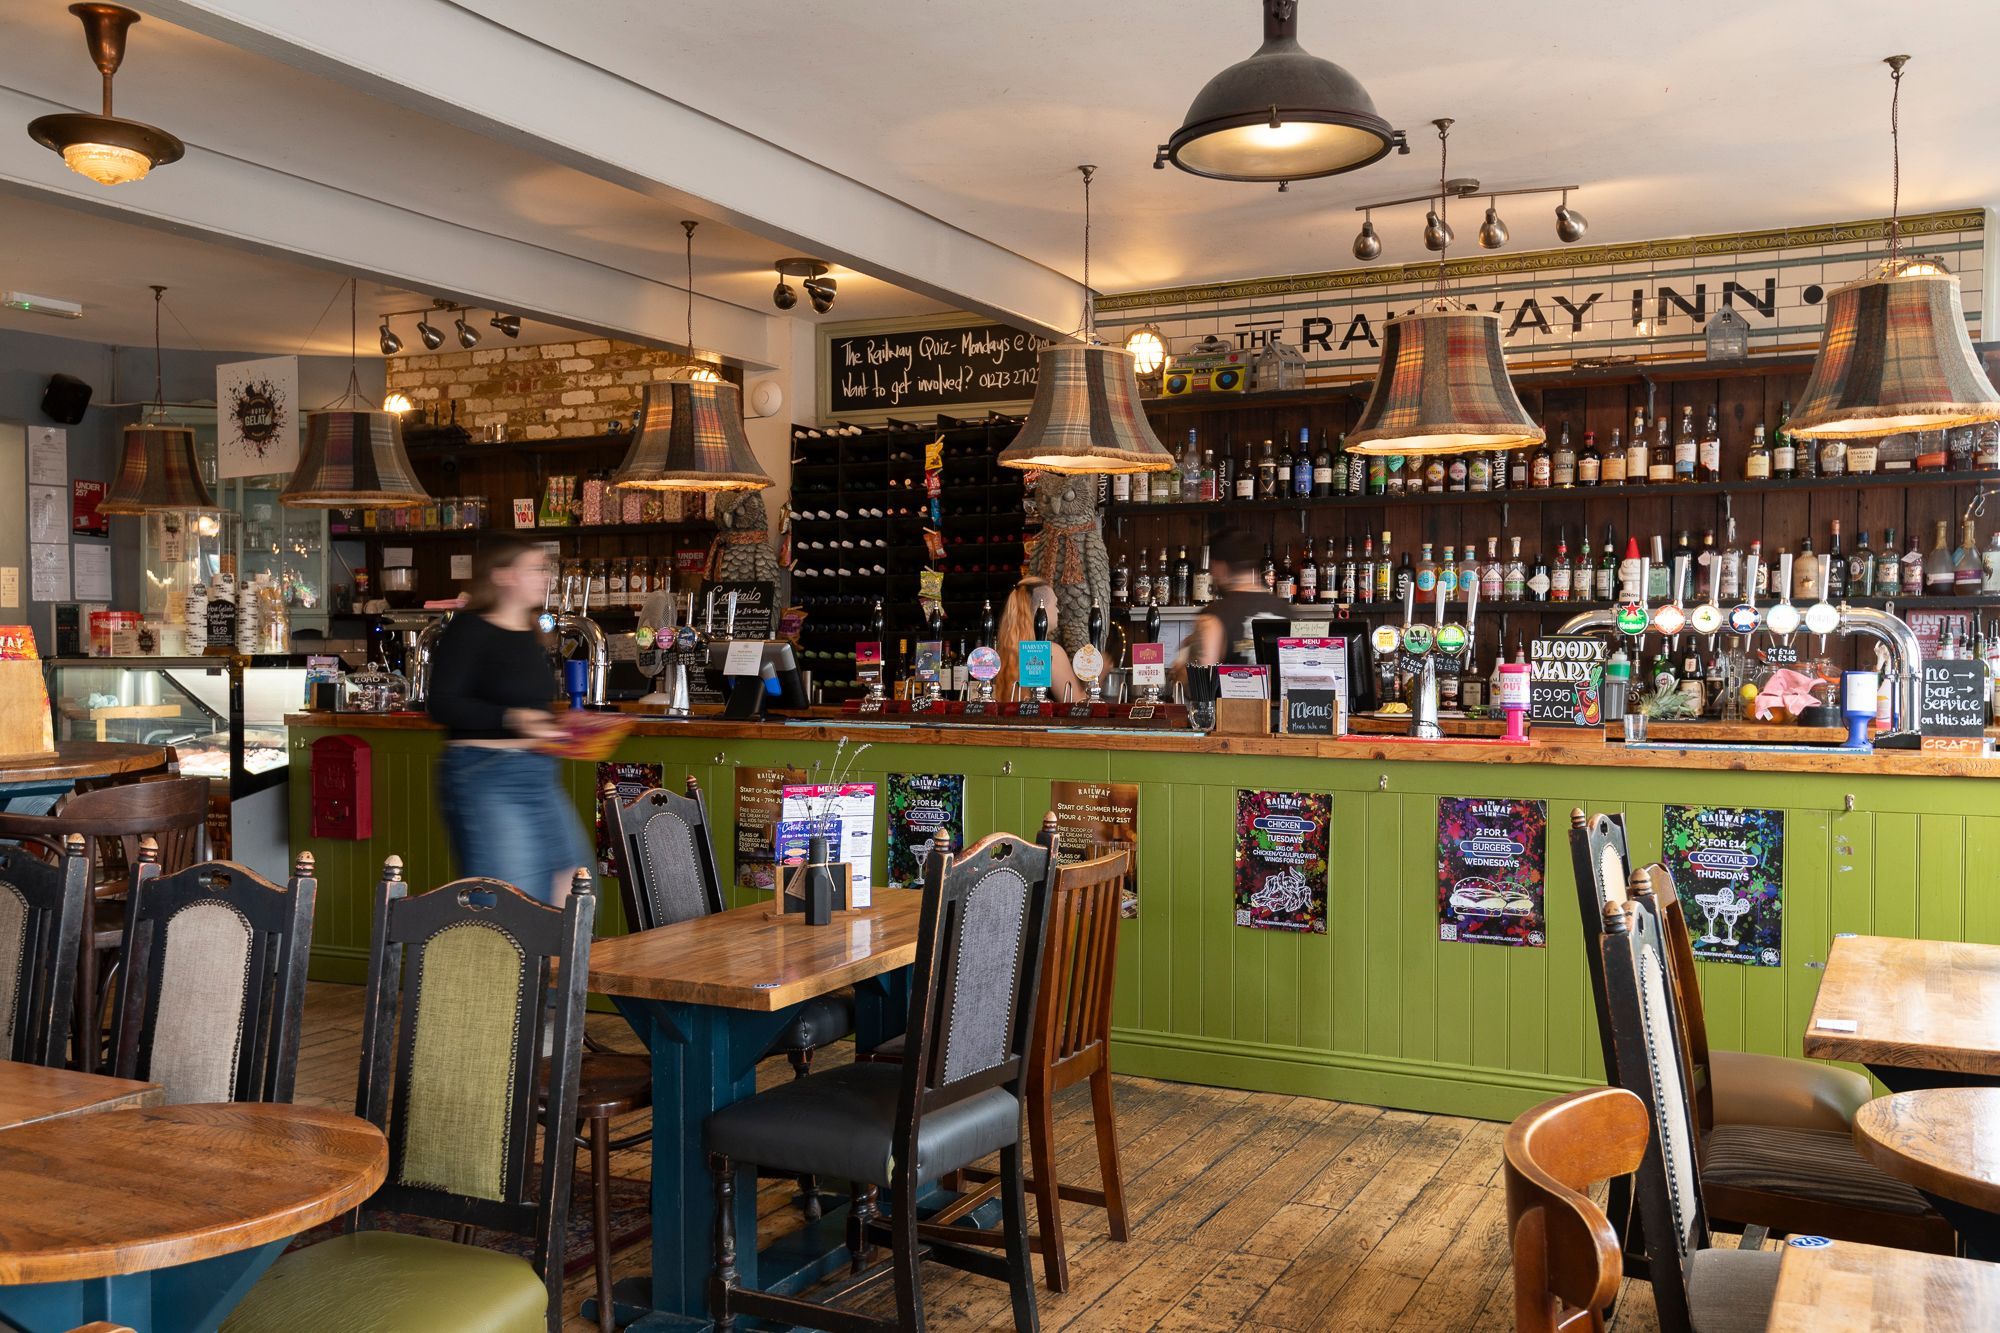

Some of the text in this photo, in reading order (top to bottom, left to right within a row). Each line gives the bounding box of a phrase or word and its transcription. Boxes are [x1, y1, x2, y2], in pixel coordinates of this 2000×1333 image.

[1236, 278, 1776, 352] THE RAAY INN
[841, 340, 863, 366] The
[868, 338, 912, 371] Railway
[962, 330, 1010, 365] Mondays
[1013, 334, 1025, 351] @
[841, 364, 1010, 405] Want to get involved? 01273
[75, 481, 101, 491] UNDER
[678, 552, 704, 560] UNDER
[1911, 614, 1966, 625] UNDER
[1912, 625, 1938, 635] 25?
[1531, 640, 1607, 660] BLOODY
[1531, 661, 1597, 680] MARY
[1925, 667, 1950, 681] no
[1503, 683, 1521, 691] OUT
[1925, 684, 1955, 699] bar
[1533, 688, 1571, 702] £9.95
[1291, 702, 1333, 719] Menus
[1533, 705, 1574, 718] EACH
[1936, 713, 1959, 725] this
[1960, 713, 1982, 725] side
[1923, 739, 1979, 751] CRAFT
[911, 779, 942, 787] RAILWAY
[817, 785, 843, 793] MENU
[1078, 788, 1111, 797] RAILWAY
[931, 800, 943, 808] £14
[1266, 797, 1302, 807] RAILWAY
[1085, 804, 1111, 813] SUMMER
[1112, 806, 1133, 814] HAPPY
[1472, 804, 1512, 815] RAILWAY
[910, 812, 945, 820] COCKTAILS
[1101, 815, 1116, 823] JULY
[1116, 816, 1131, 824] 21ST
[1701, 813, 1746, 825] RAILWAY
[1267, 820, 1301, 829] CHICKEN
[1476, 828, 1508, 837] 2 FOR 1
[1266, 834, 1304, 844] TUESDAYS
[1699, 838, 1747, 850] 2 FOR £14
[1472, 842, 1512, 852] BURGERS
[1253, 849, 1317, 860] CHICKEN/CAULIFLOWER
[1697, 854, 1749, 865] COCKTAILS
[1464, 857, 1520, 868] WEDNESDAYS
[1696, 869, 1750, 881] THURSDAYS
